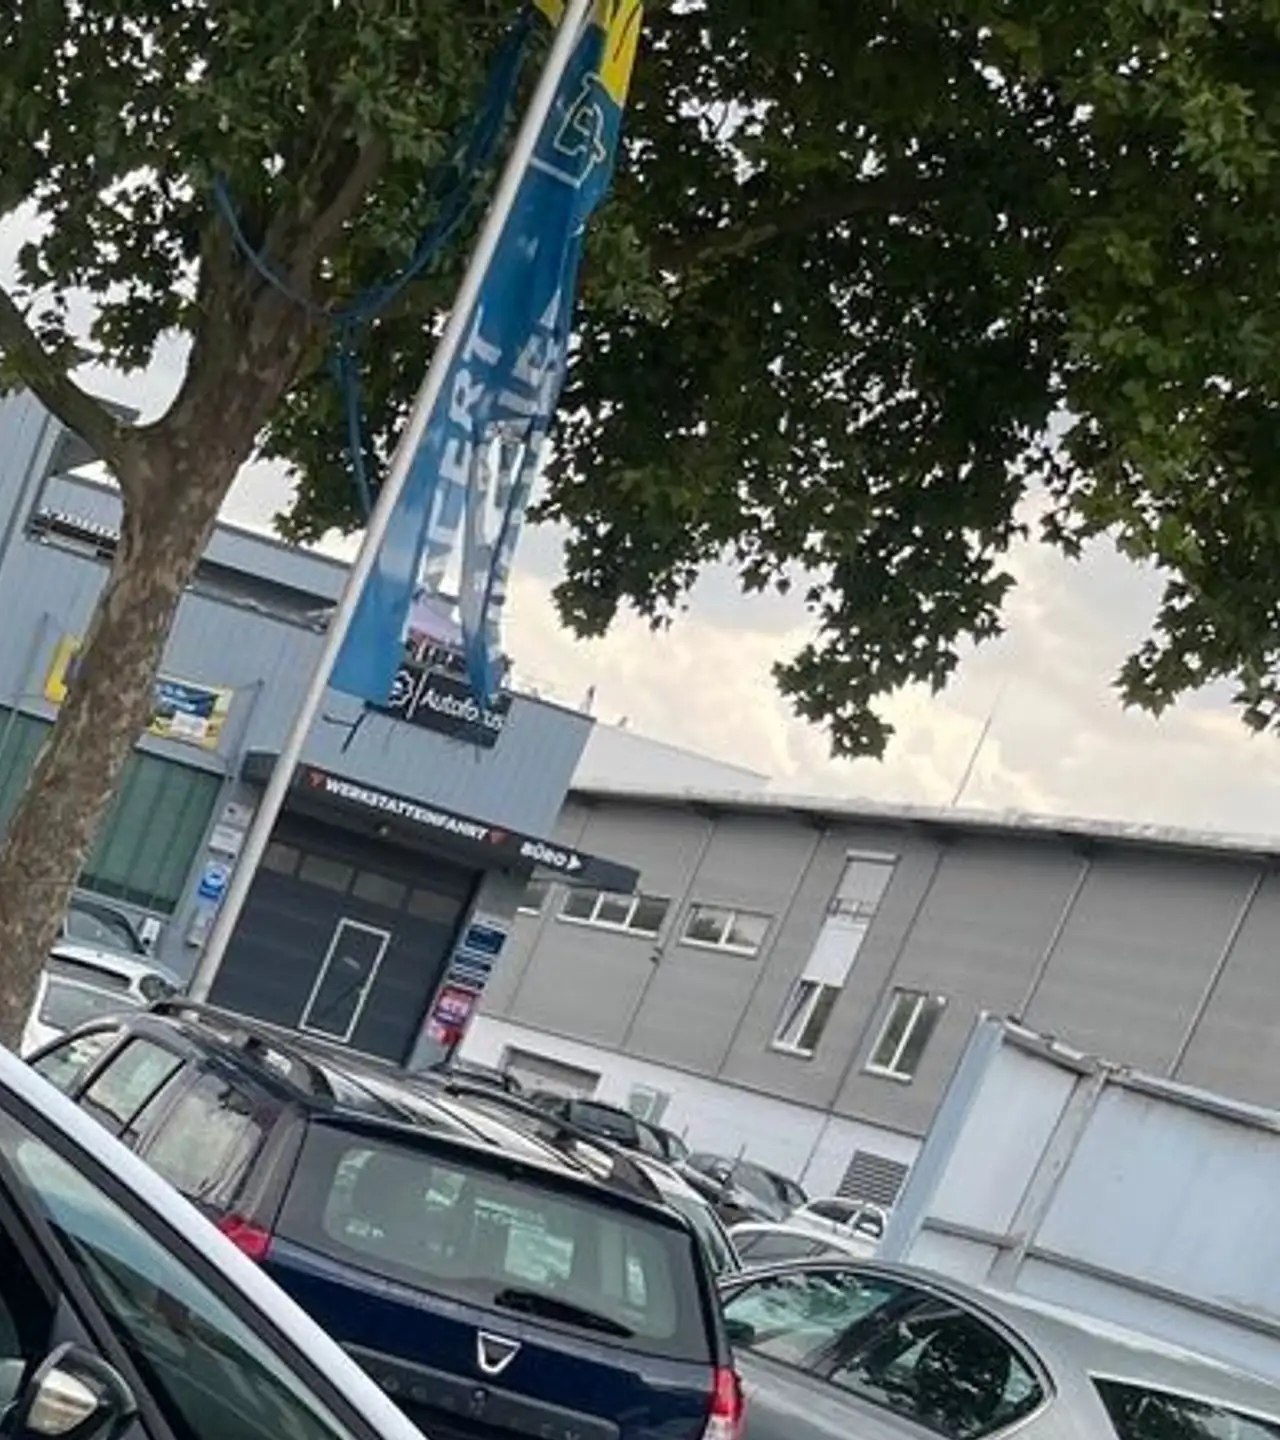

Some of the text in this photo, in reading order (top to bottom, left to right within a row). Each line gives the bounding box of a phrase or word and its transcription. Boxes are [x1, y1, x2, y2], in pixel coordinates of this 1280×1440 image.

[420, 687, 503, 731] Autofous
[325, 777, 489, 841] WERKSTATTEINFAHRT
[520, 841, 566, 867] BÜRO
